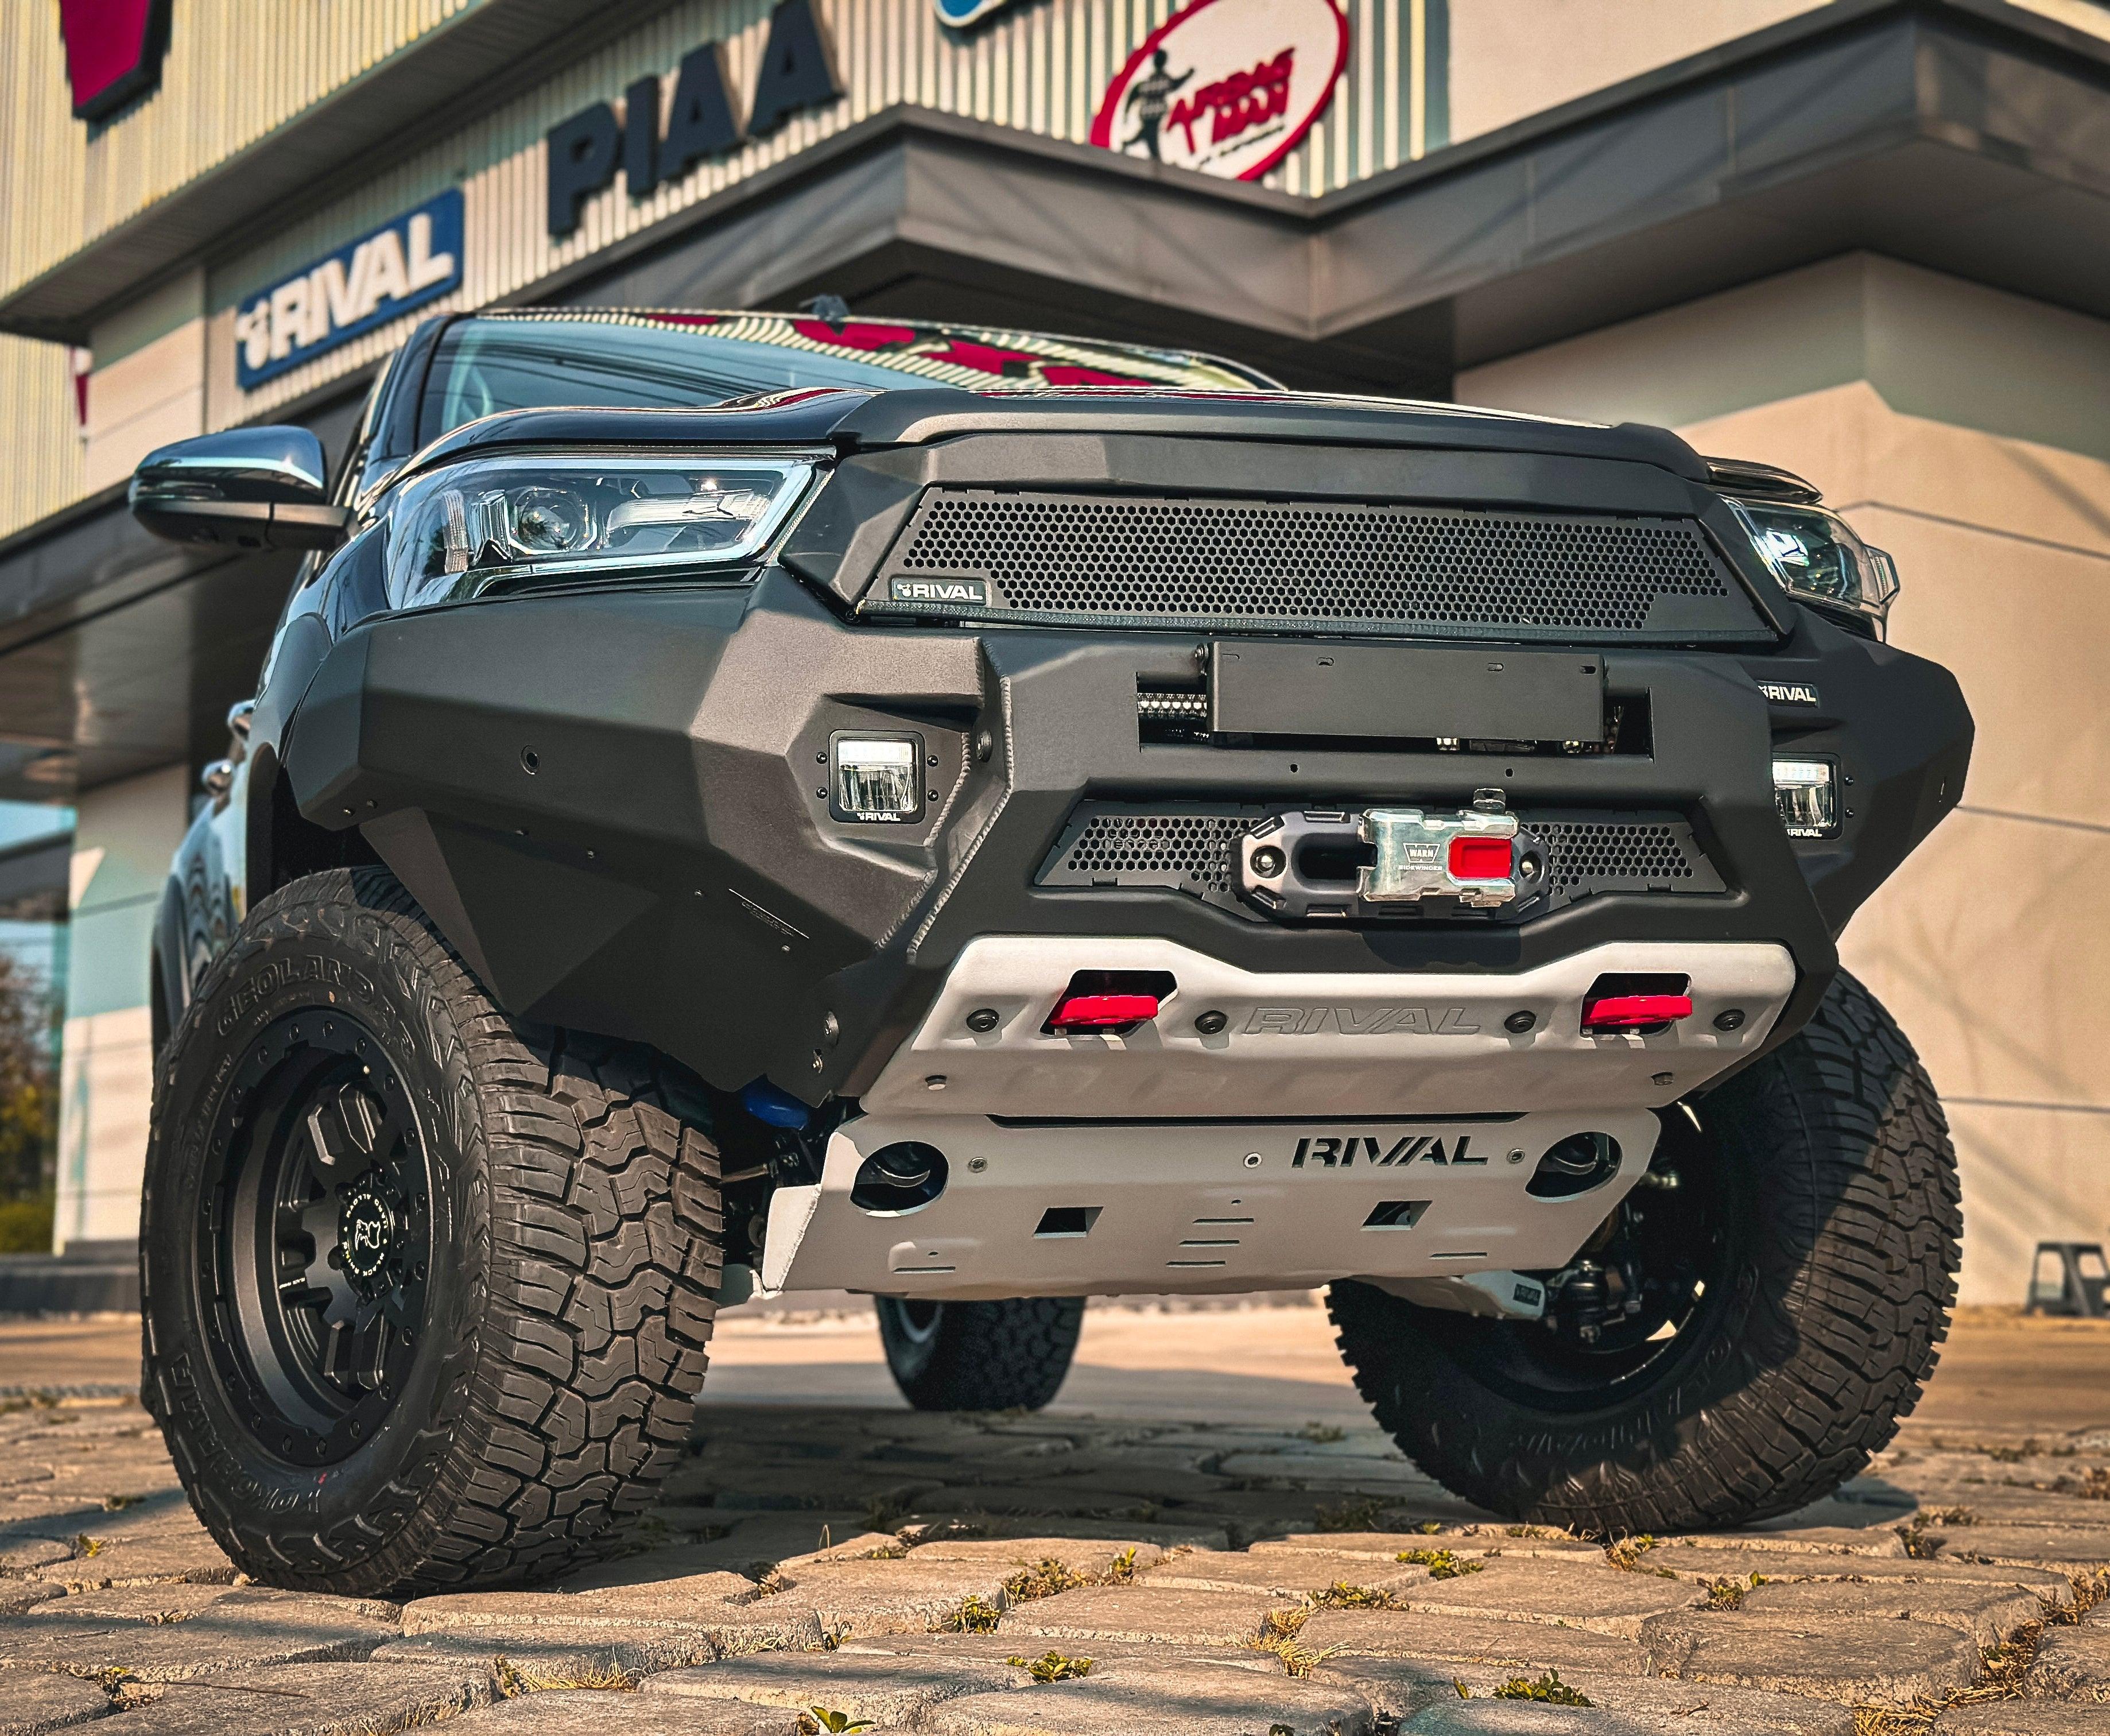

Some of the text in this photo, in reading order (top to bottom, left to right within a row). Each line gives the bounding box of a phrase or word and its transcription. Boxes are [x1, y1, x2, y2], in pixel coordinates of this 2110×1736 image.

[547, 0, 841, 235] PIAA
[270, 212, 454, 361] RIVAL
[912, 583, 983, 600] RIVAL
[1768, 685, 1816, 702] RIVAL
[865, 812, 901, 822] RIVAL
[1790, 828, 1822, 837] RIVAL
[1409, 849, 1434, 858] WARN
[1241, 1008, 1481, 1035] RIVAL
[1291, 1135, 1489, 1168] RIVAL
